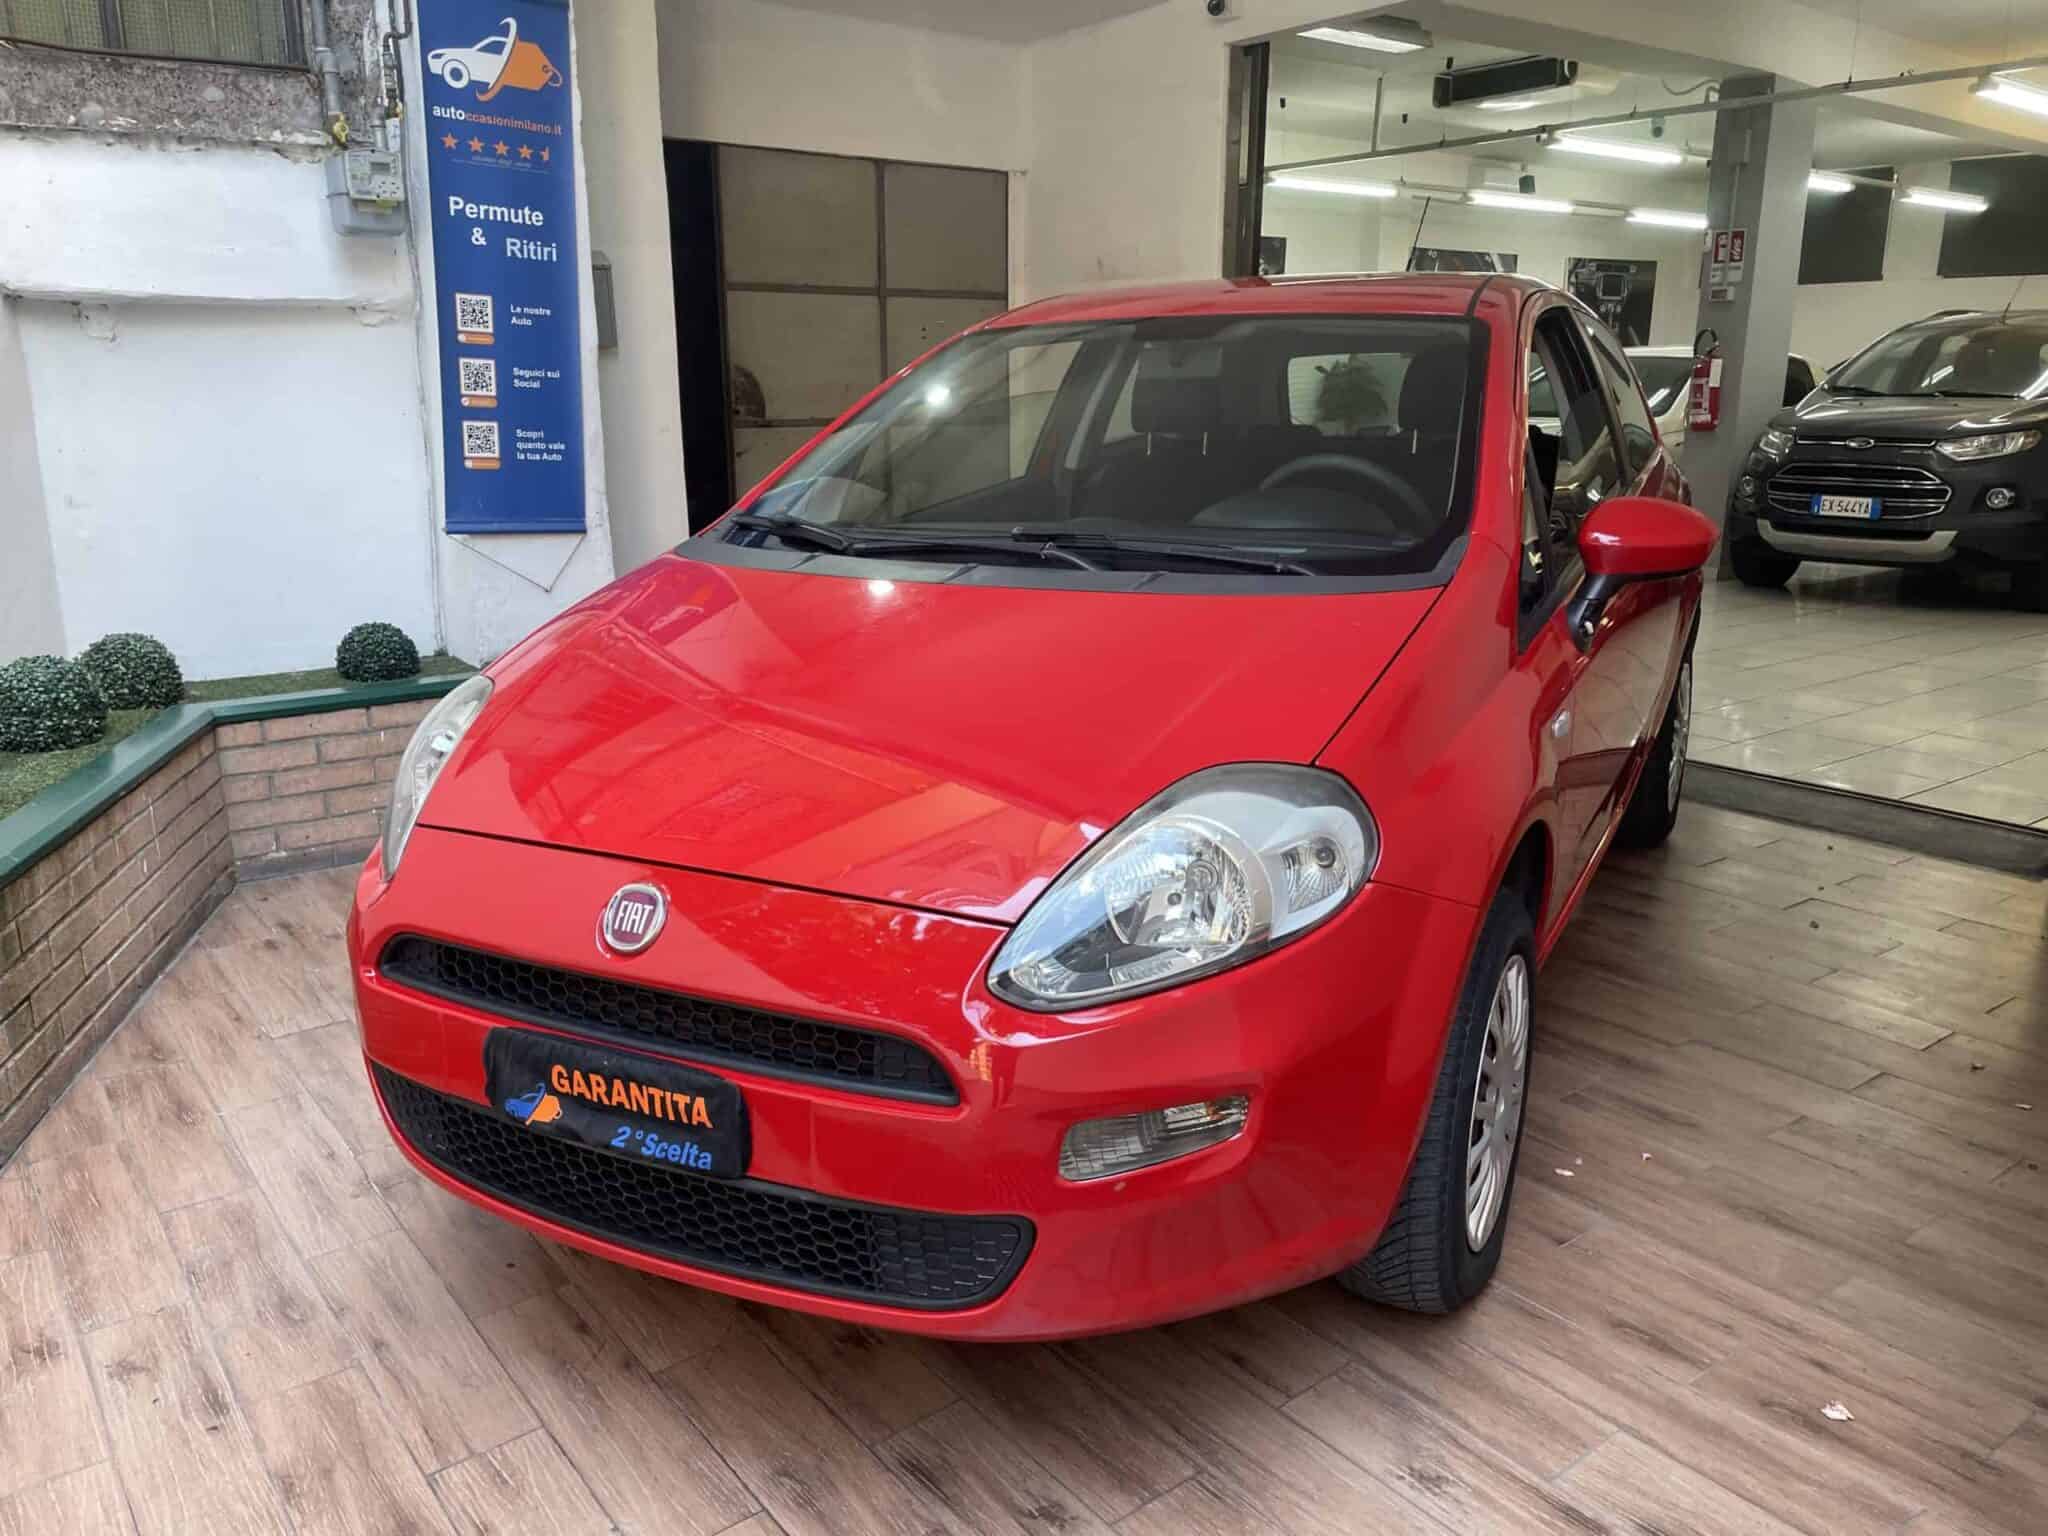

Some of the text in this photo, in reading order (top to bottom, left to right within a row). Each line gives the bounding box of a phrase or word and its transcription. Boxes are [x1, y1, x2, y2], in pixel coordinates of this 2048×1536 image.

[448, 195, 544, 226] Permute
[471, 226, 558, 262] & Ritiri
[510, 304, 551, 317] Le nostre
[511, 316, 532, 326] Auto
[512, 367, 560, 379] Seguici sui
[513, 378, 541, 389] Social
[516, 428, 544, 439] Scopri
[516, 440, 566, 451] quanto vale
[516, 452, 562, 461] la tua Auto
[614, 901, 654, 934] FIAT
[551, 1064, 714, 1129] GARANTITA
